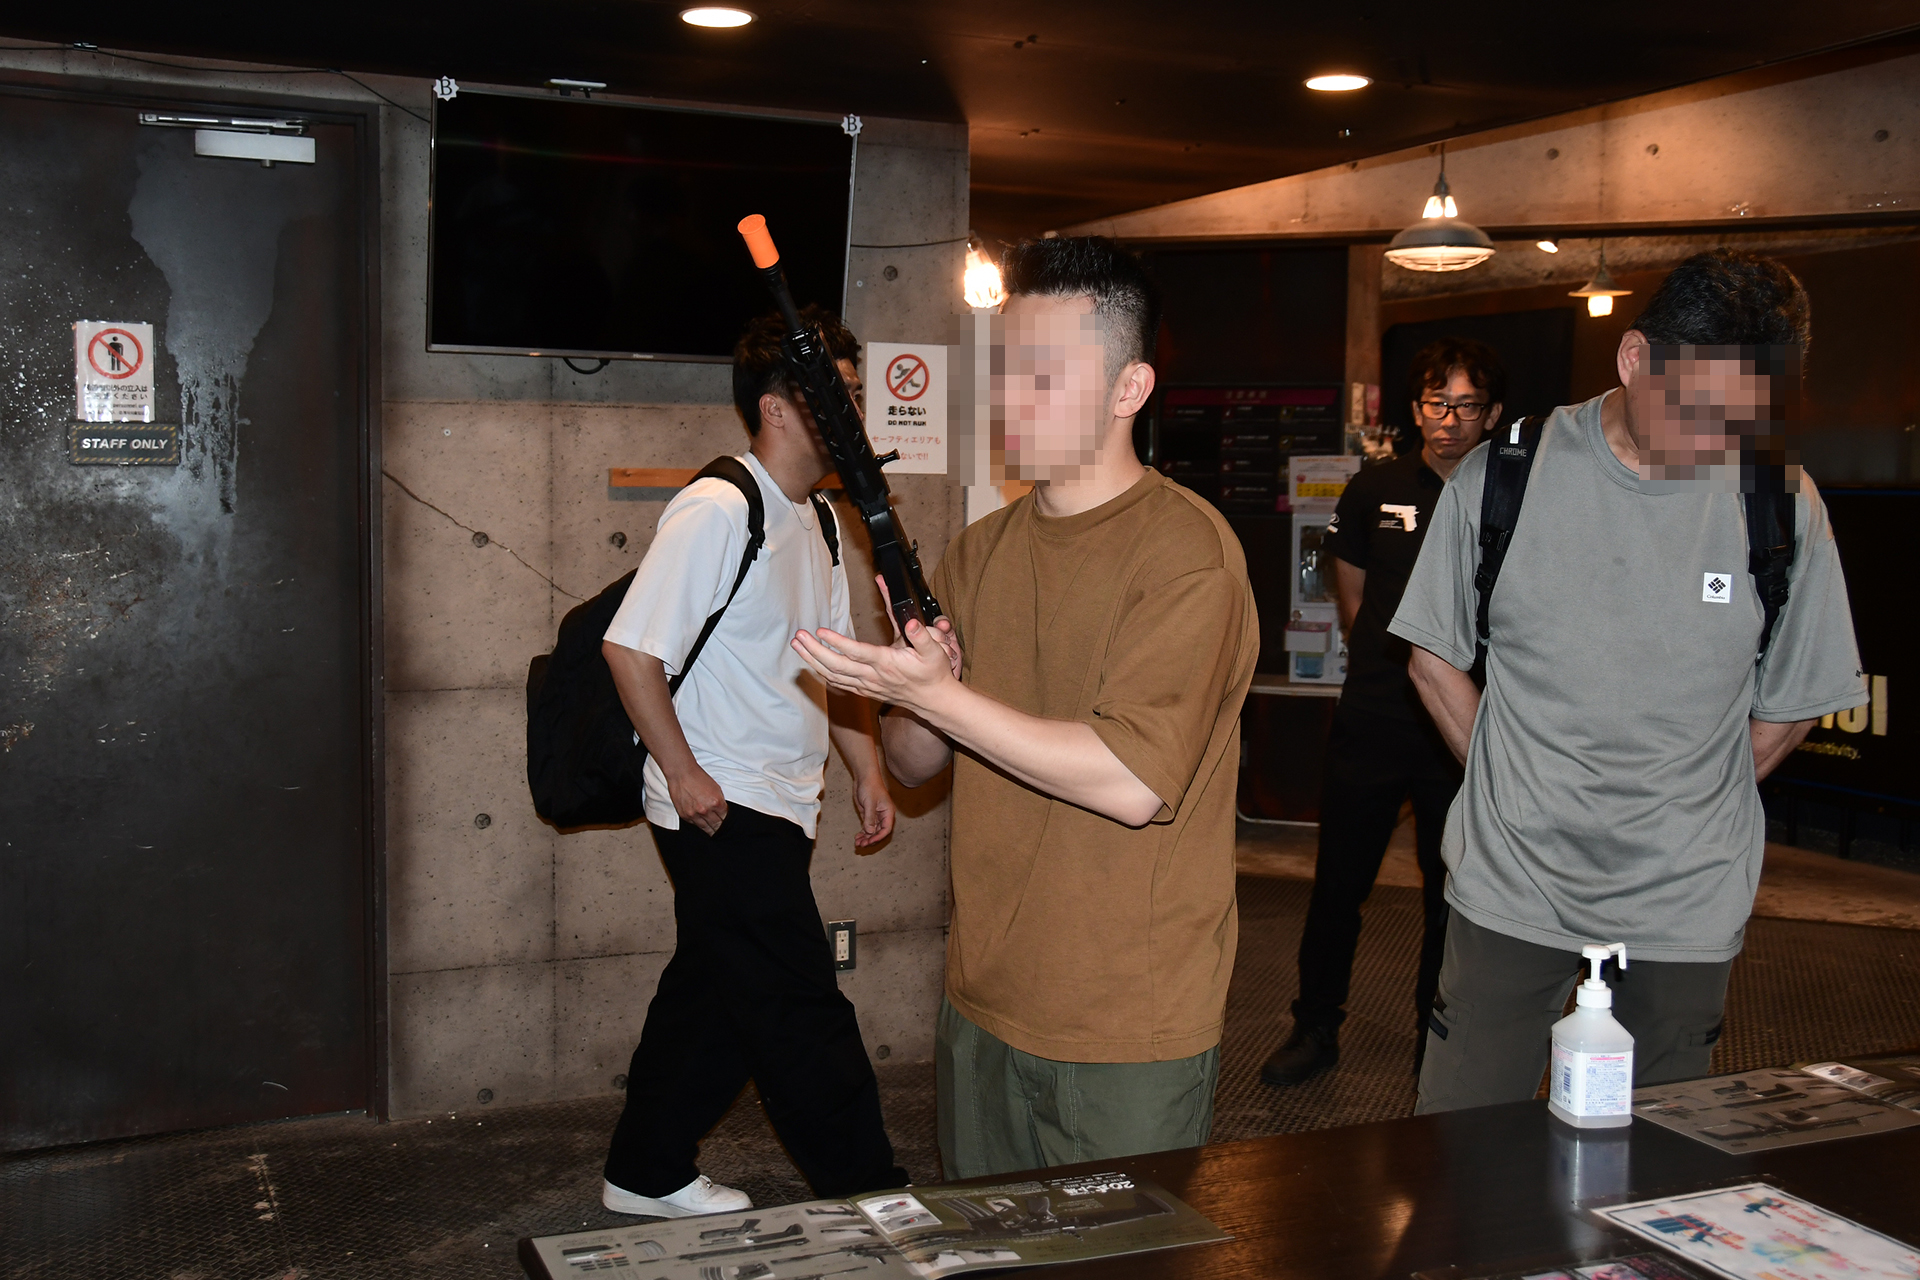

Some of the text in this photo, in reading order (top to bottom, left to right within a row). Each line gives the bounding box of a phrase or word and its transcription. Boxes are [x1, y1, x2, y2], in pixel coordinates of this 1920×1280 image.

[440, 79, 453, 96] B
[847, 116, 858, 132] B
[887, 405, 927, 416] 走らない
[82, 438, 168, 449] STAFF ONLY
[872, 436, 941, 444] セーフティエリアも
[900, 451, 929, 460] ないで!!
[1499, 446, 1528, 458] CHROME
